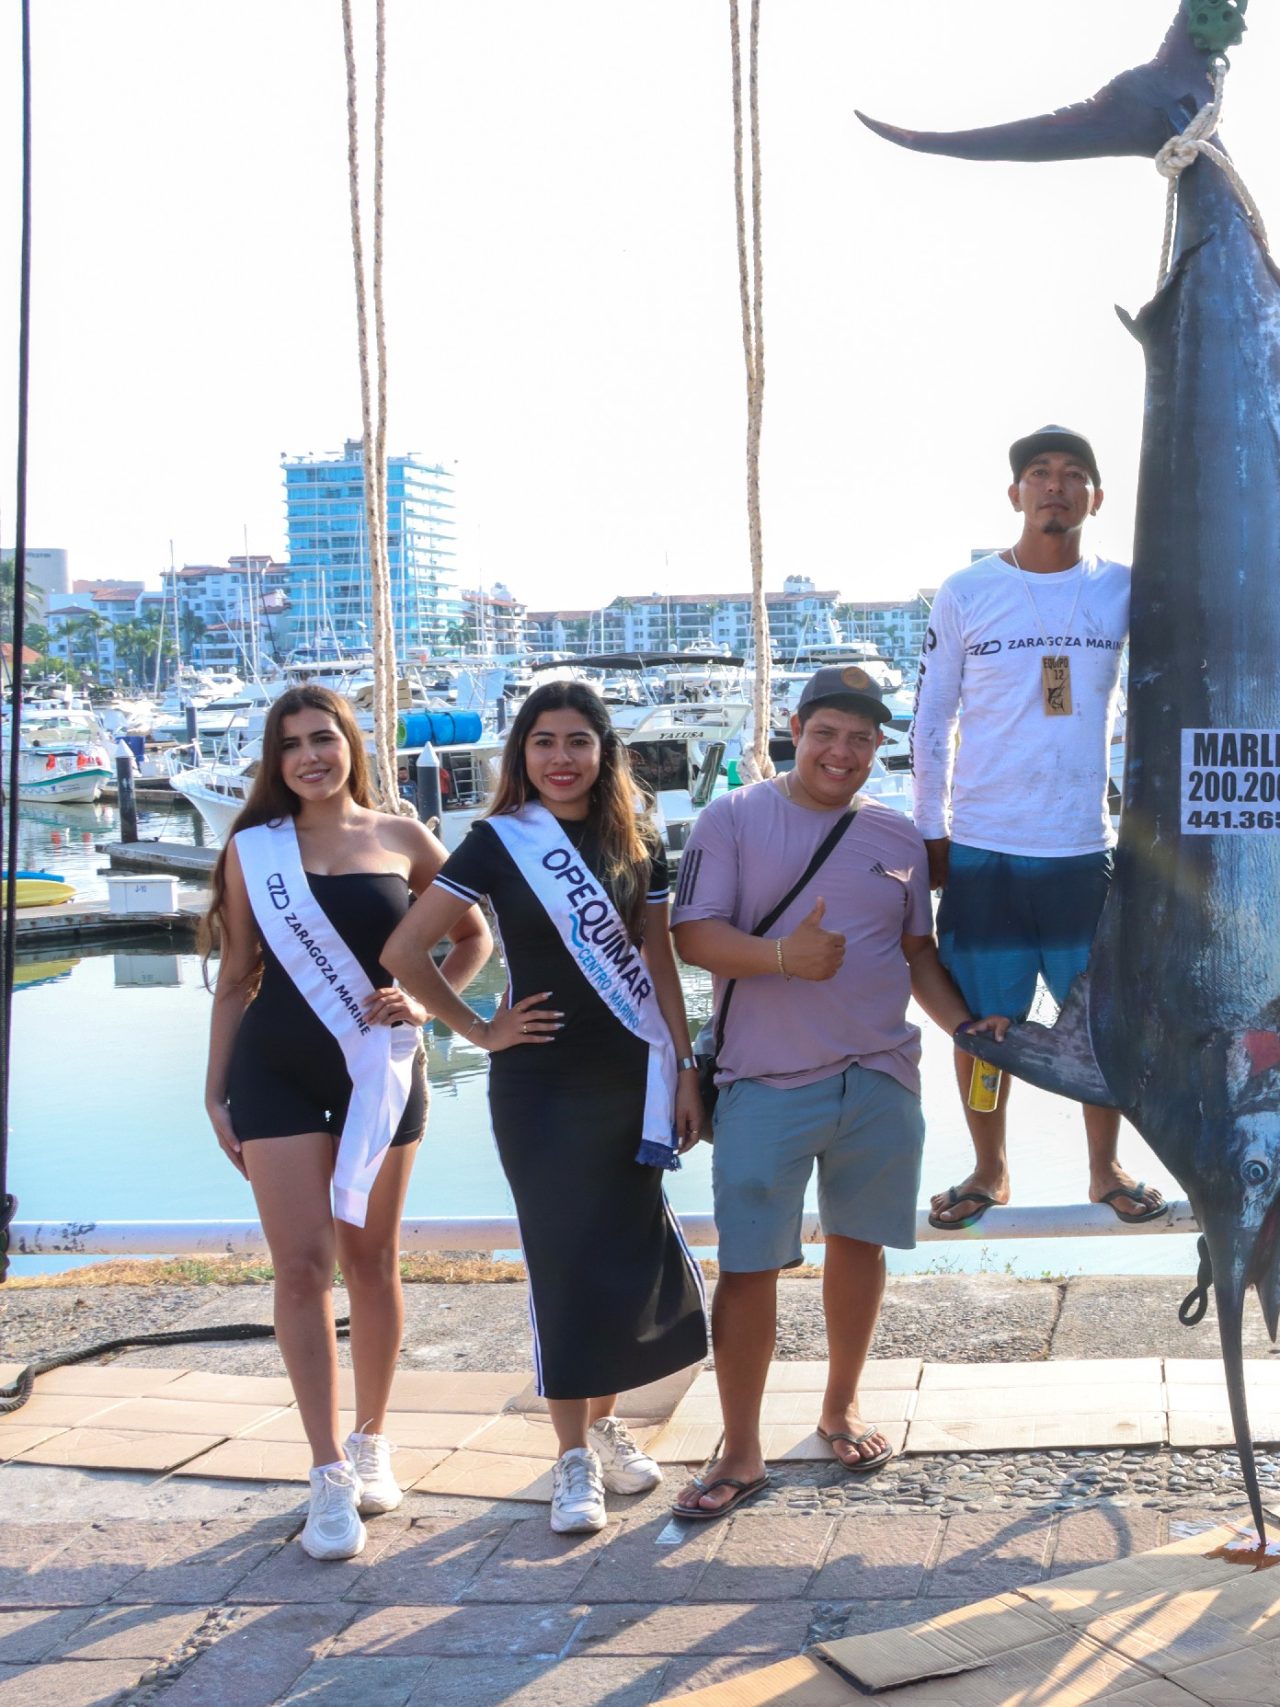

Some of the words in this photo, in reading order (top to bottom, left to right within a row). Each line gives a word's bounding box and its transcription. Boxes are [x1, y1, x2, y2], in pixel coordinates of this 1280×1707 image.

[1008, 636, 1081, 649] ZARAGOZA
[1043, 657, 1069, 669] EQUIPO
[542, 849, 652, 1006] OPEQUIMAR
[284, 912, 339, 985] ZARAGOZA
[335, 985, 371, 1037] MARINE
[578, 948, 612, 991] CENTRO
[608, 991, 640, 1030] MARINO
